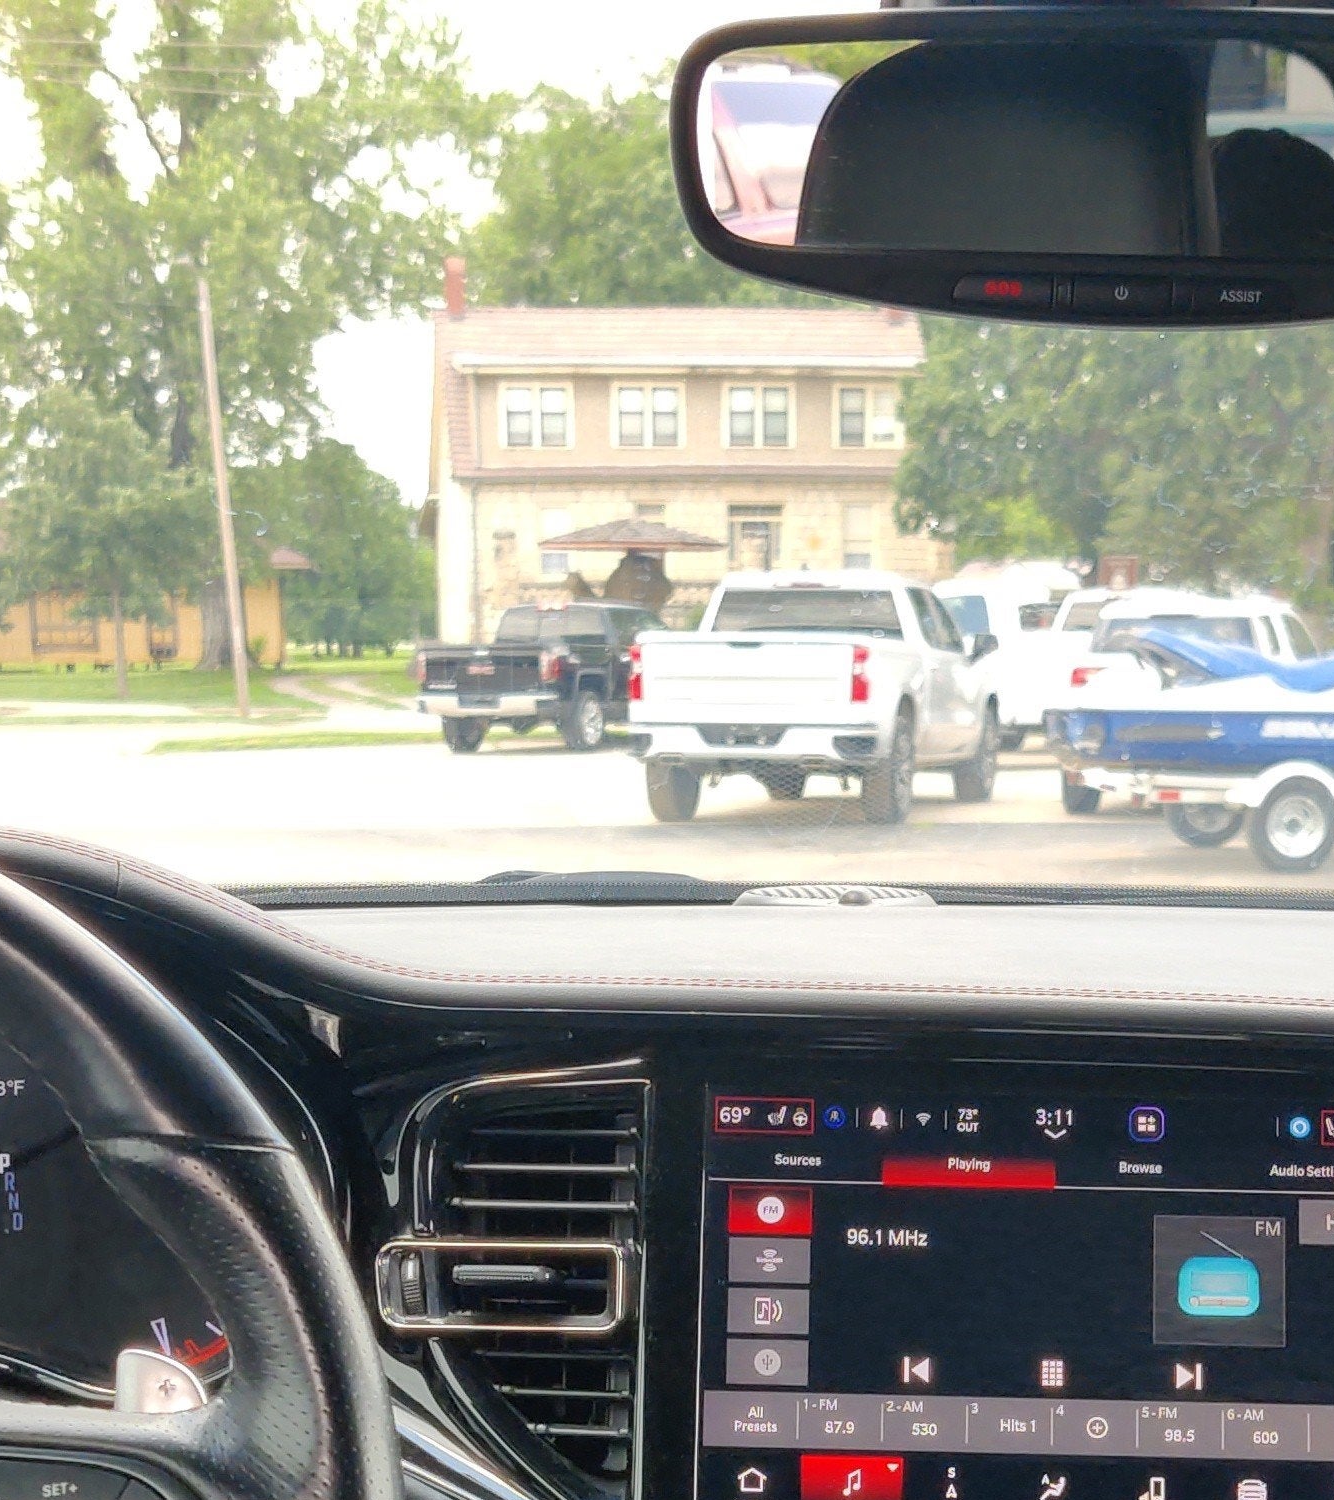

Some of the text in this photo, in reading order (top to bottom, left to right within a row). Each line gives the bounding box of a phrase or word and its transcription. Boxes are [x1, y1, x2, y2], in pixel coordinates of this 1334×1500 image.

[1220, 289, 1263, 304] ASSIST
[719, 1106, 752, 1124] 69°
[1035, 1108, 1074, 1126] 3:11
[956, 1122, 979, 1133] OUT
[774, 1153, 822, 1168] Sources
[947, 1157, 991, 1173] Playing
[1118, 1161, 1163, 1175] Browse
[1269, 1164, 1304, 1178] Audio
[1255, 1220, 1281, 1237] FM
[847, 1229, 928, 1247] 96.1 MHz
[748, 1406, 764, 1419] All
[734, 1420, 778, 1433] Presets
[825, 1421, 855, 1435] 87.9
[911, 1423, 938, 1437] 530
[1000, 1419, 1027, 1433] Hits
[1164, 1428, 1195, 1443] 98.5
